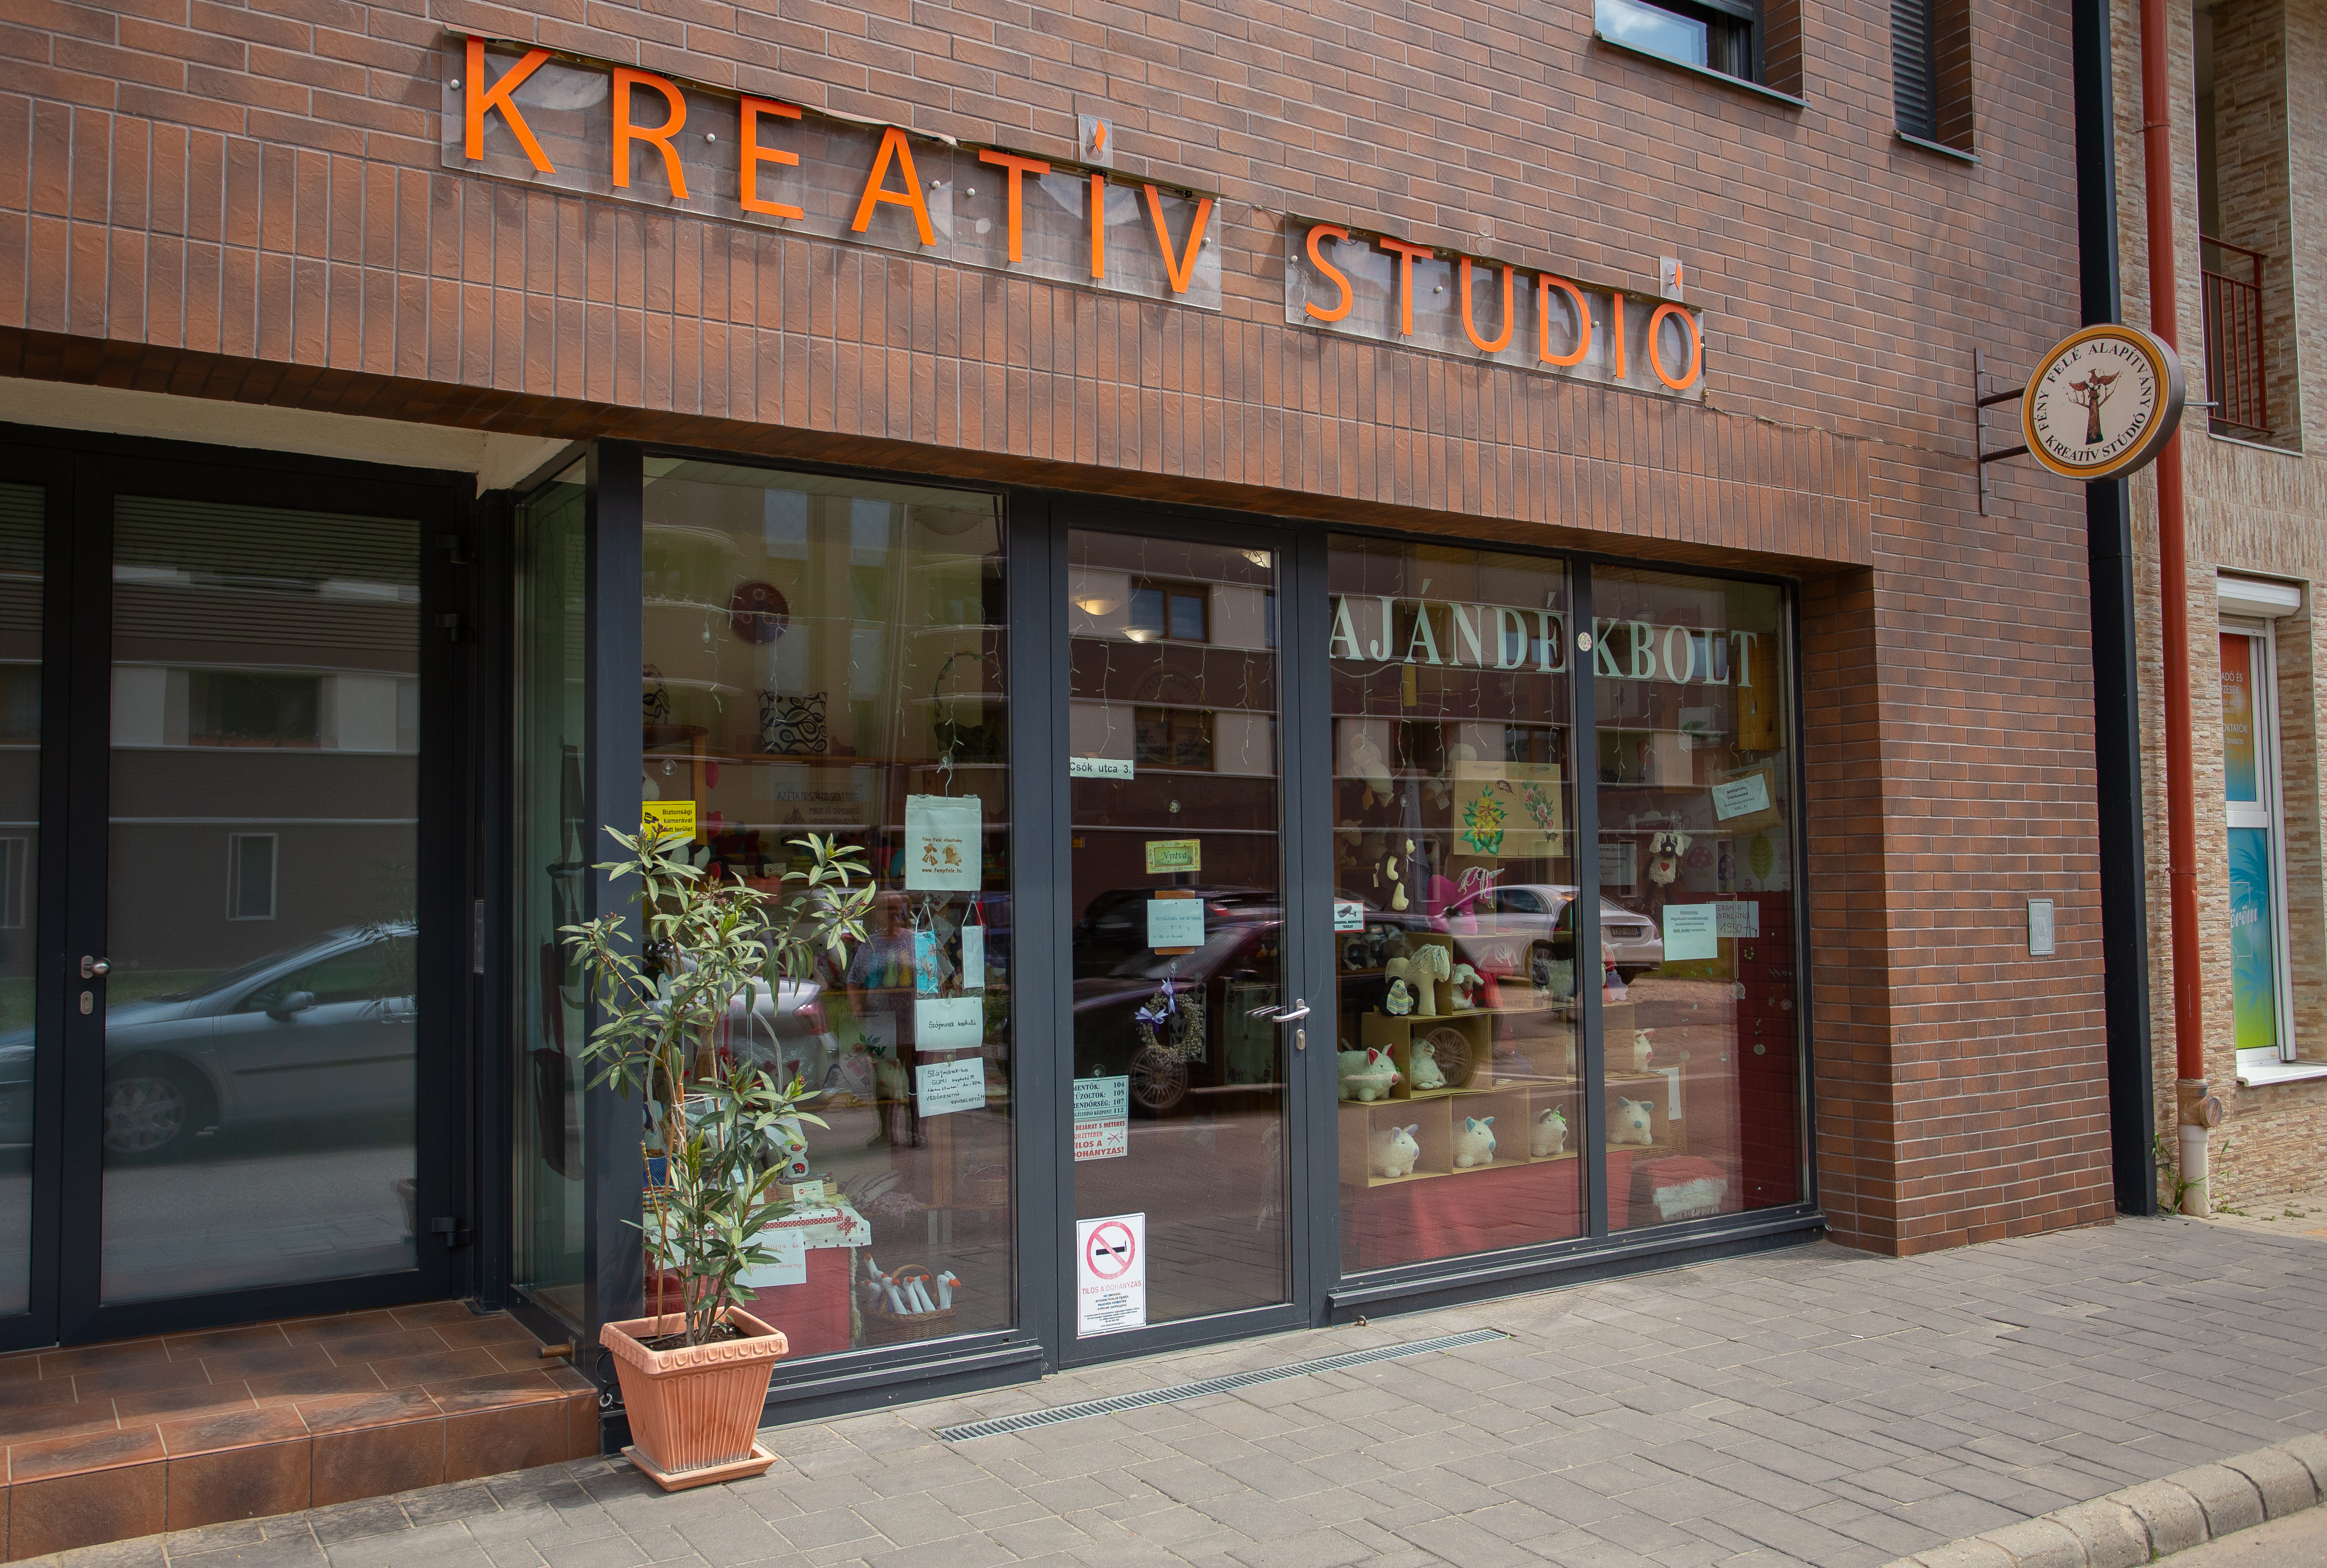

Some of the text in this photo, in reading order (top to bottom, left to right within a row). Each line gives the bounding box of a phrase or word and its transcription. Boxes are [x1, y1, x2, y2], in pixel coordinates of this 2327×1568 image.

[2034, 342, 2154, 432] FÉNY FELÉ ALAPÍTVÁNY
[2044, 412, 2146, 462] KREATÍV STÚDIÓ
[2236, 671, 2243, 682] ÉS
[1070, 761, 1131, 774] Csók utca 3.
[1161, 851, 1187, 862] Nyitva
[929, 1020, 954, 1029] Szájmaszk
[1082, 1286, 1098, 1295] TILOS
[1106, 1279, 1141, 1291] DOHÁNYZÁS
